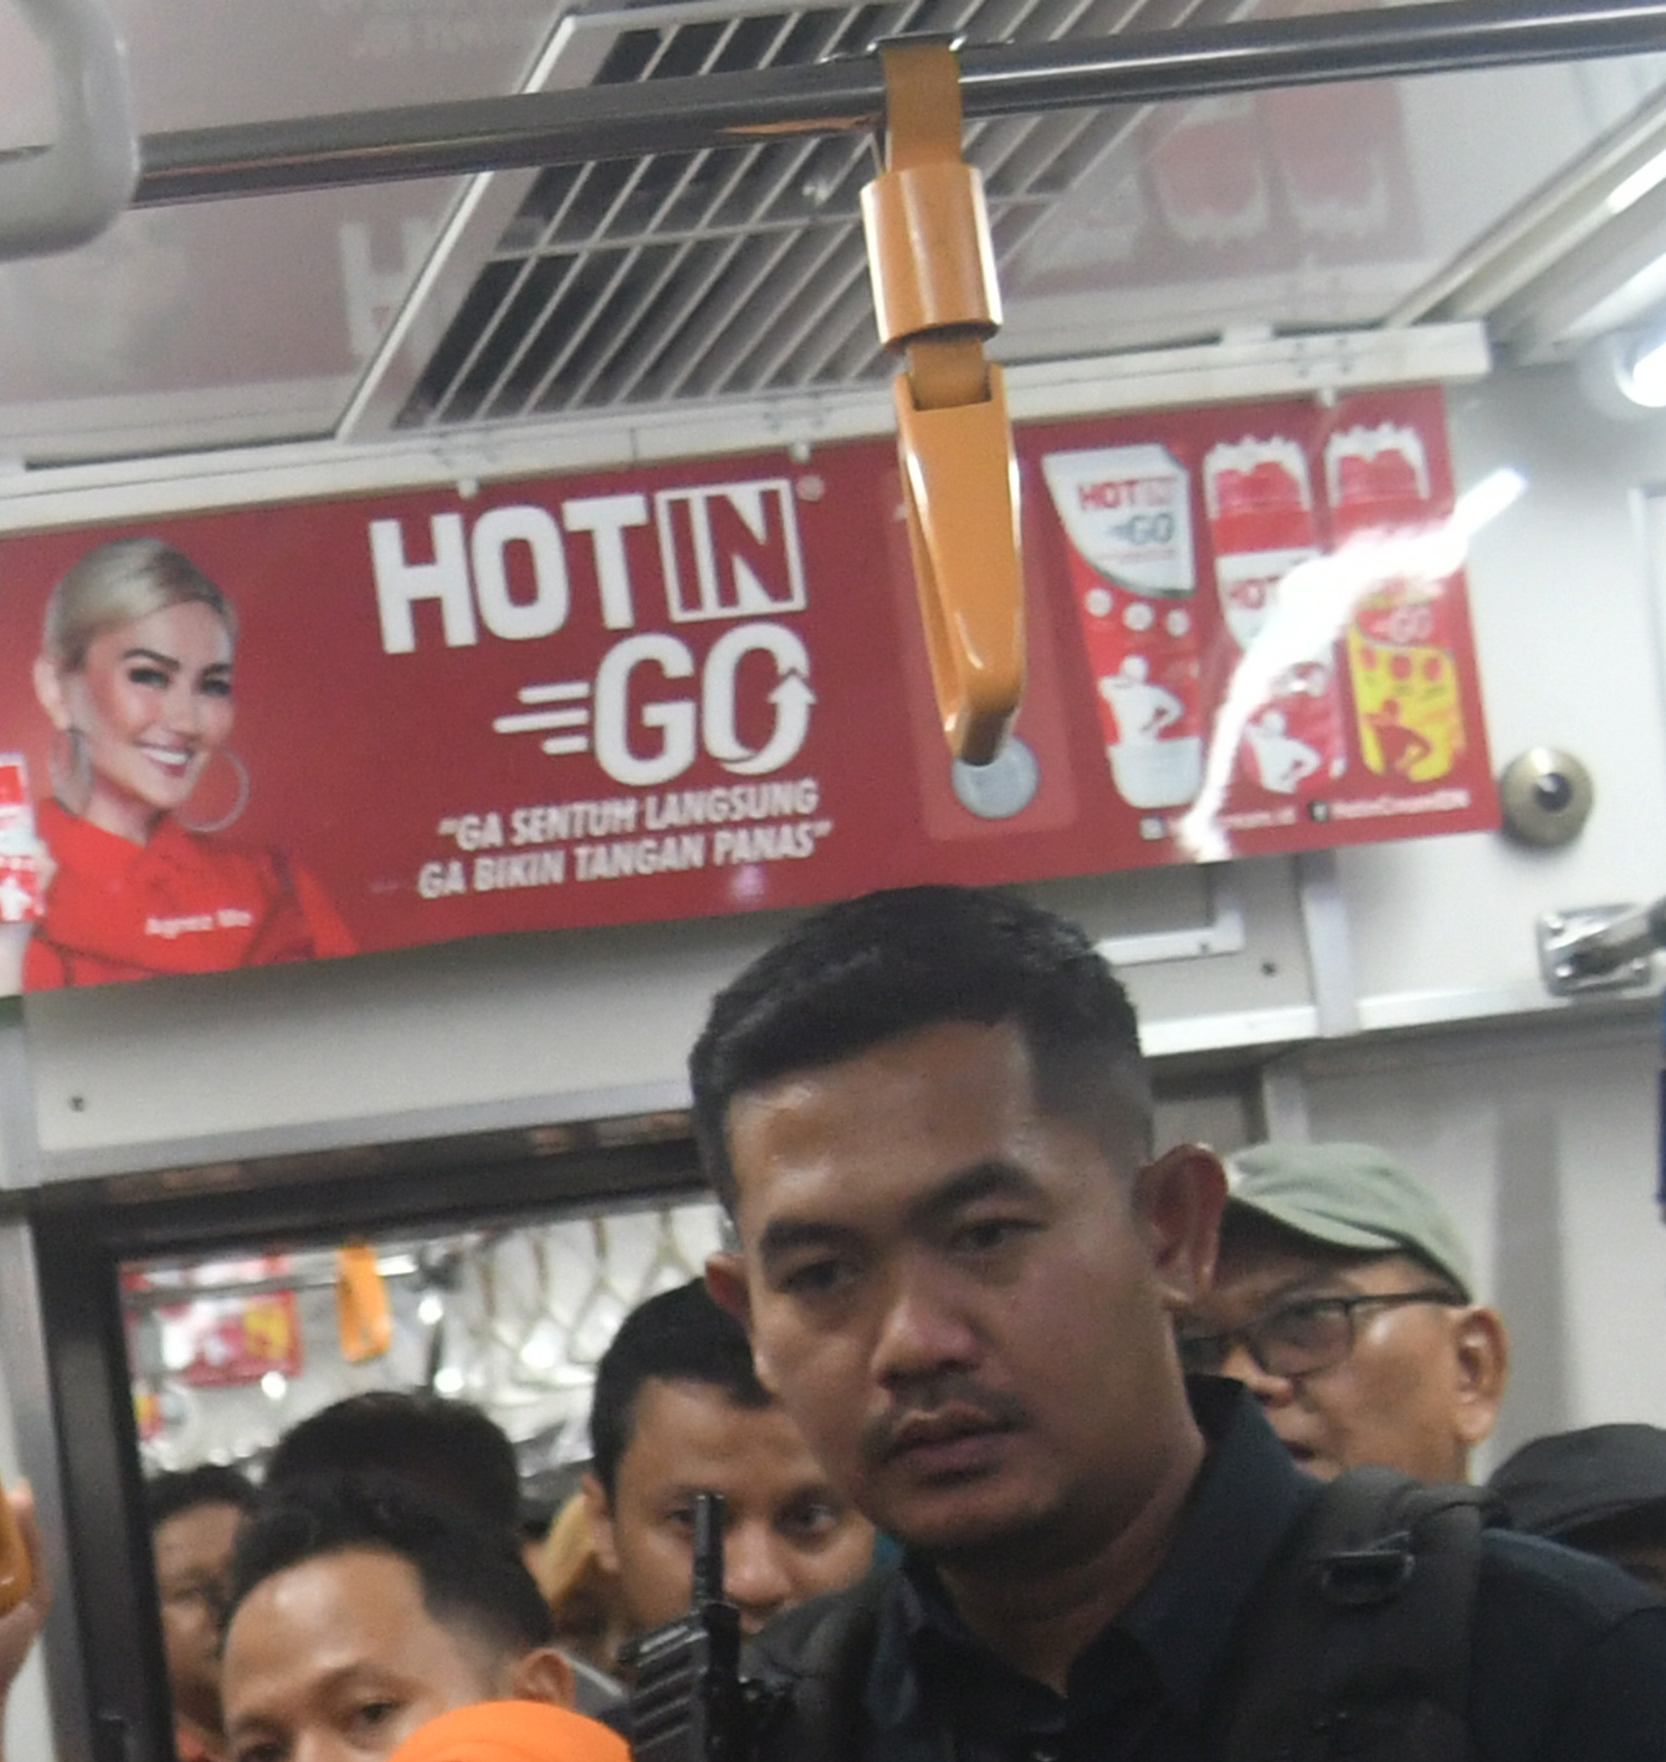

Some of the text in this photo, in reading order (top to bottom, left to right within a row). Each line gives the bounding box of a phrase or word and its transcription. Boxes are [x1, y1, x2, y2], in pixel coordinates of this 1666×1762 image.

[594, 622, 817, 786] GO
[511, 798, 636, 844] SENTUH
[644, 777, 820, 831] LANGSUNG
[417, 860, 467, 899] GA
[474, 849, 566, 892] BIKIN
[574, 833, 706, 882] TANGAN
